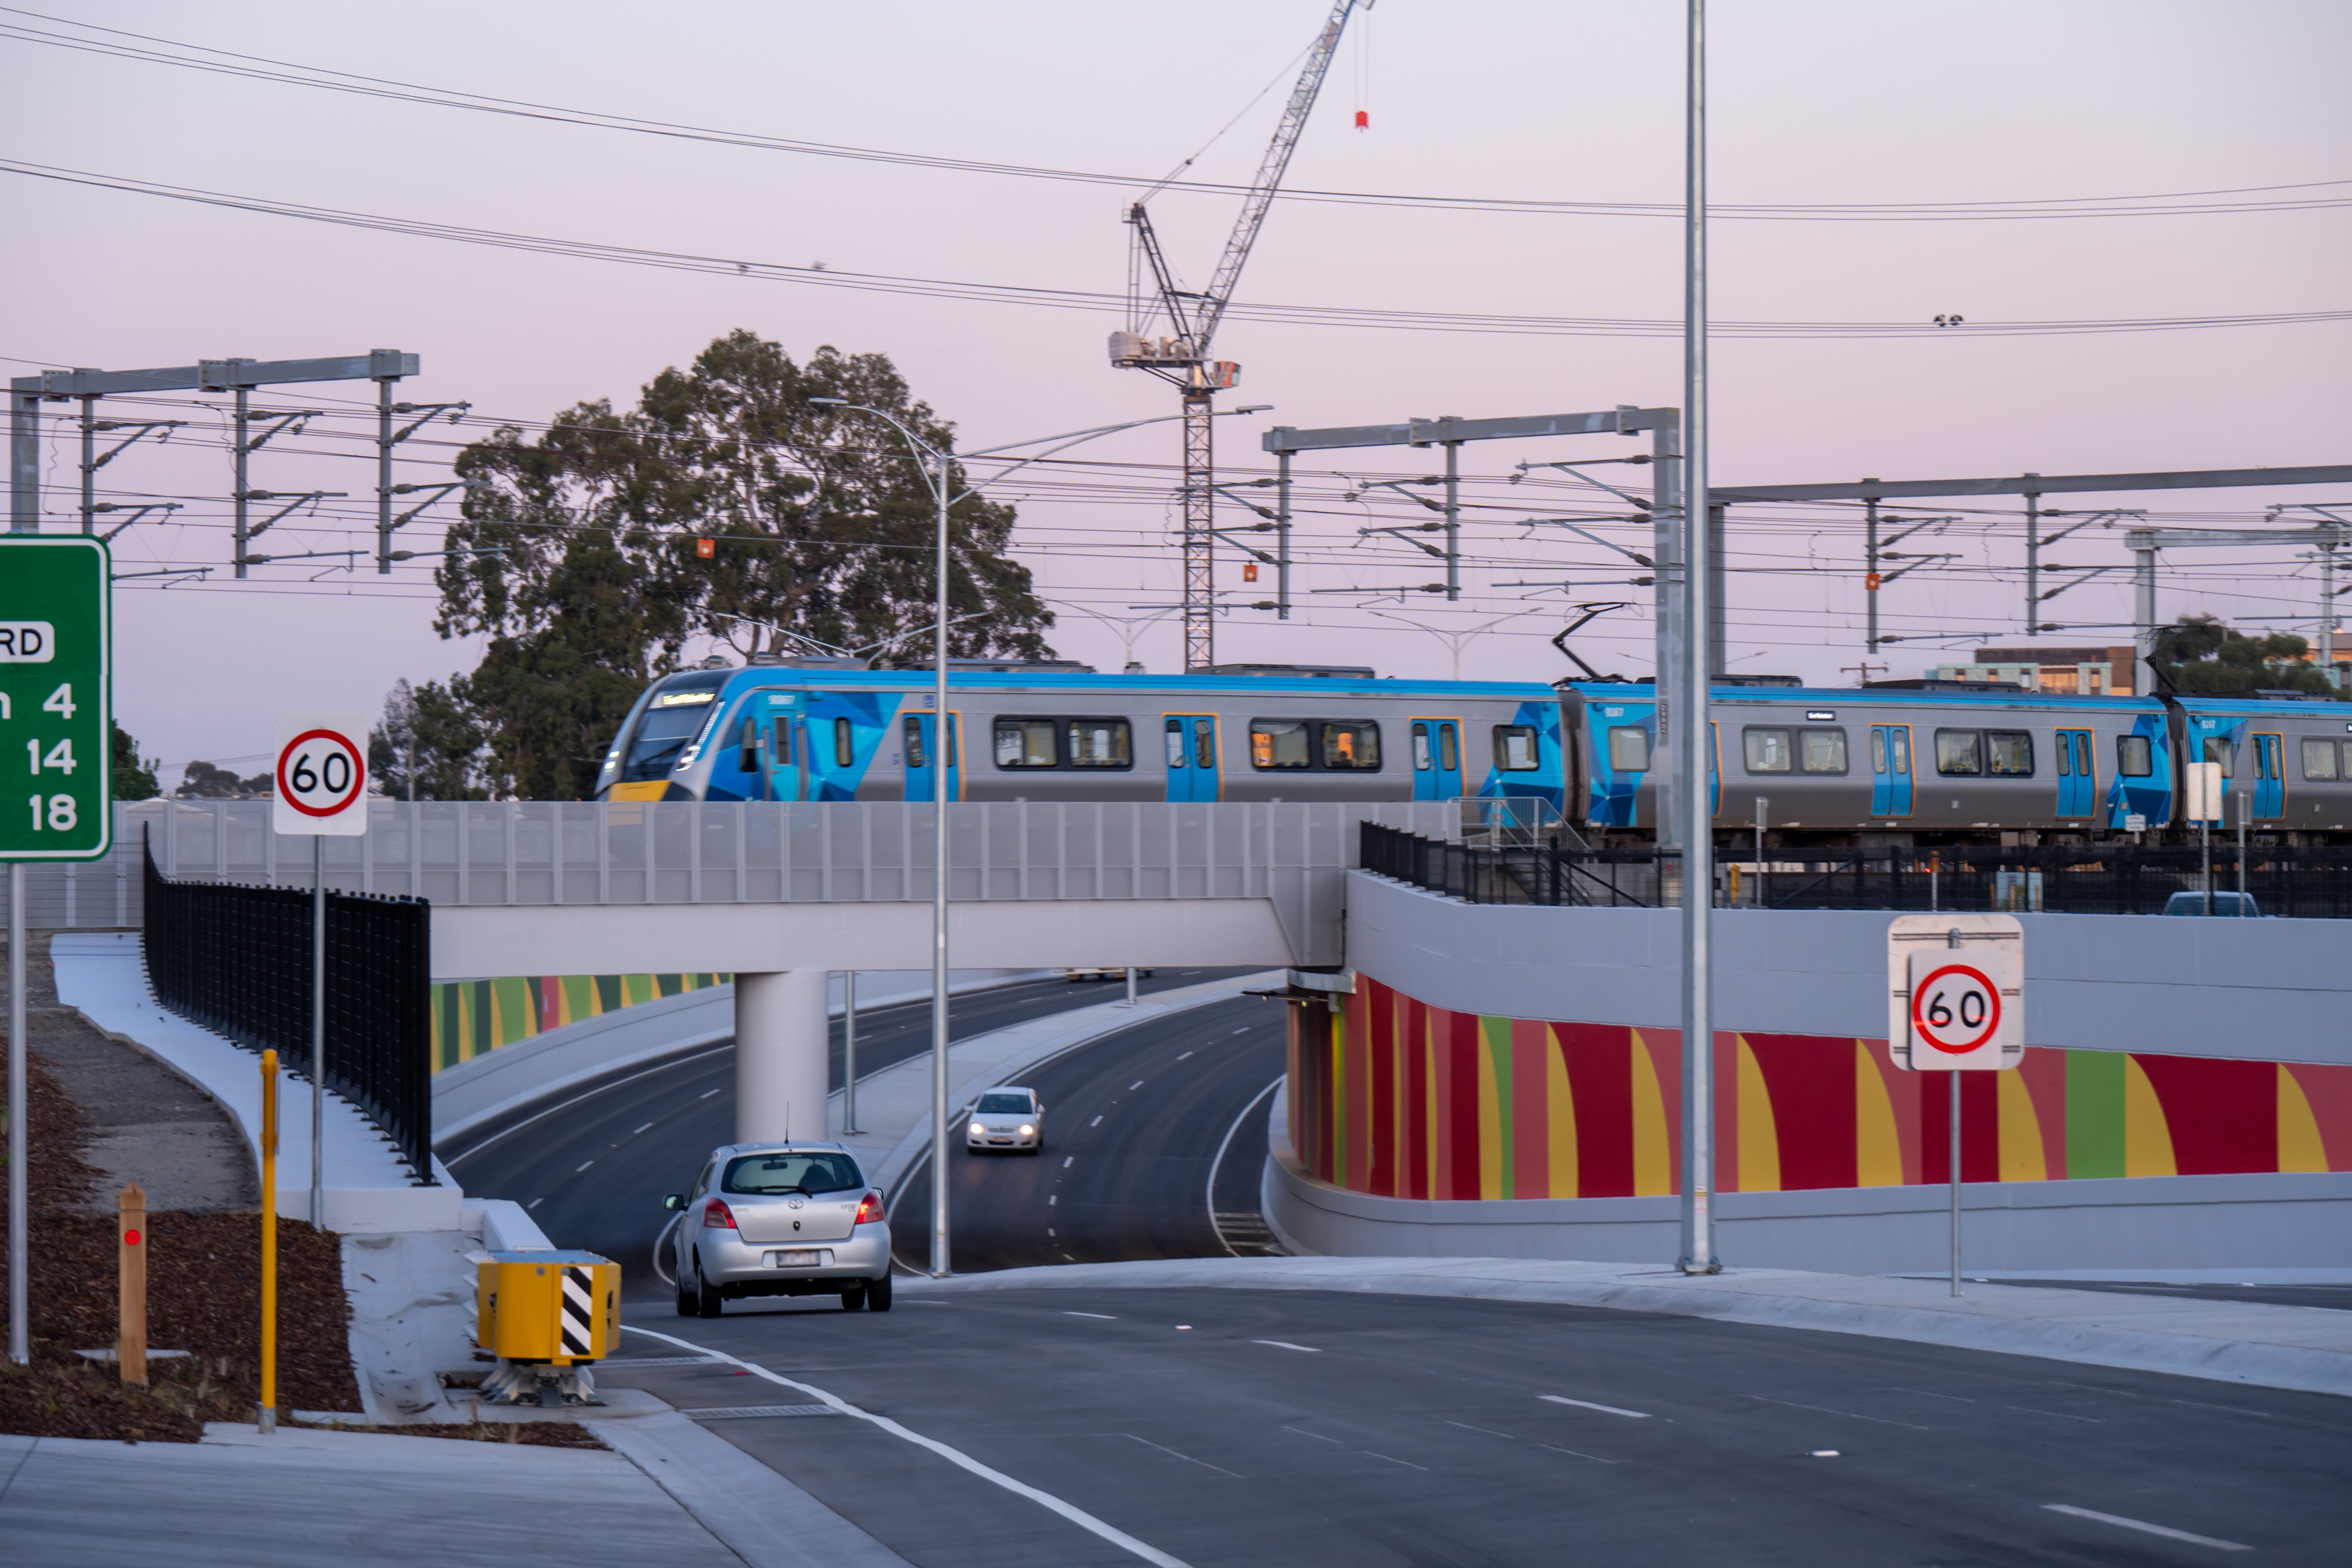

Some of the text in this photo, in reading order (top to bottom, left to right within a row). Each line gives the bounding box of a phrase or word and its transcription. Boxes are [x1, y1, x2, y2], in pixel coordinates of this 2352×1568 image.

[0, 628, 42, 655] RD
[43, 683, 76, 719] 4
[27, 739, 77, 775] 14
[292, 752, 350, 793] 60
[30, 794, 77, 831] 18
[1928, 991, 1985, 1028] 60
